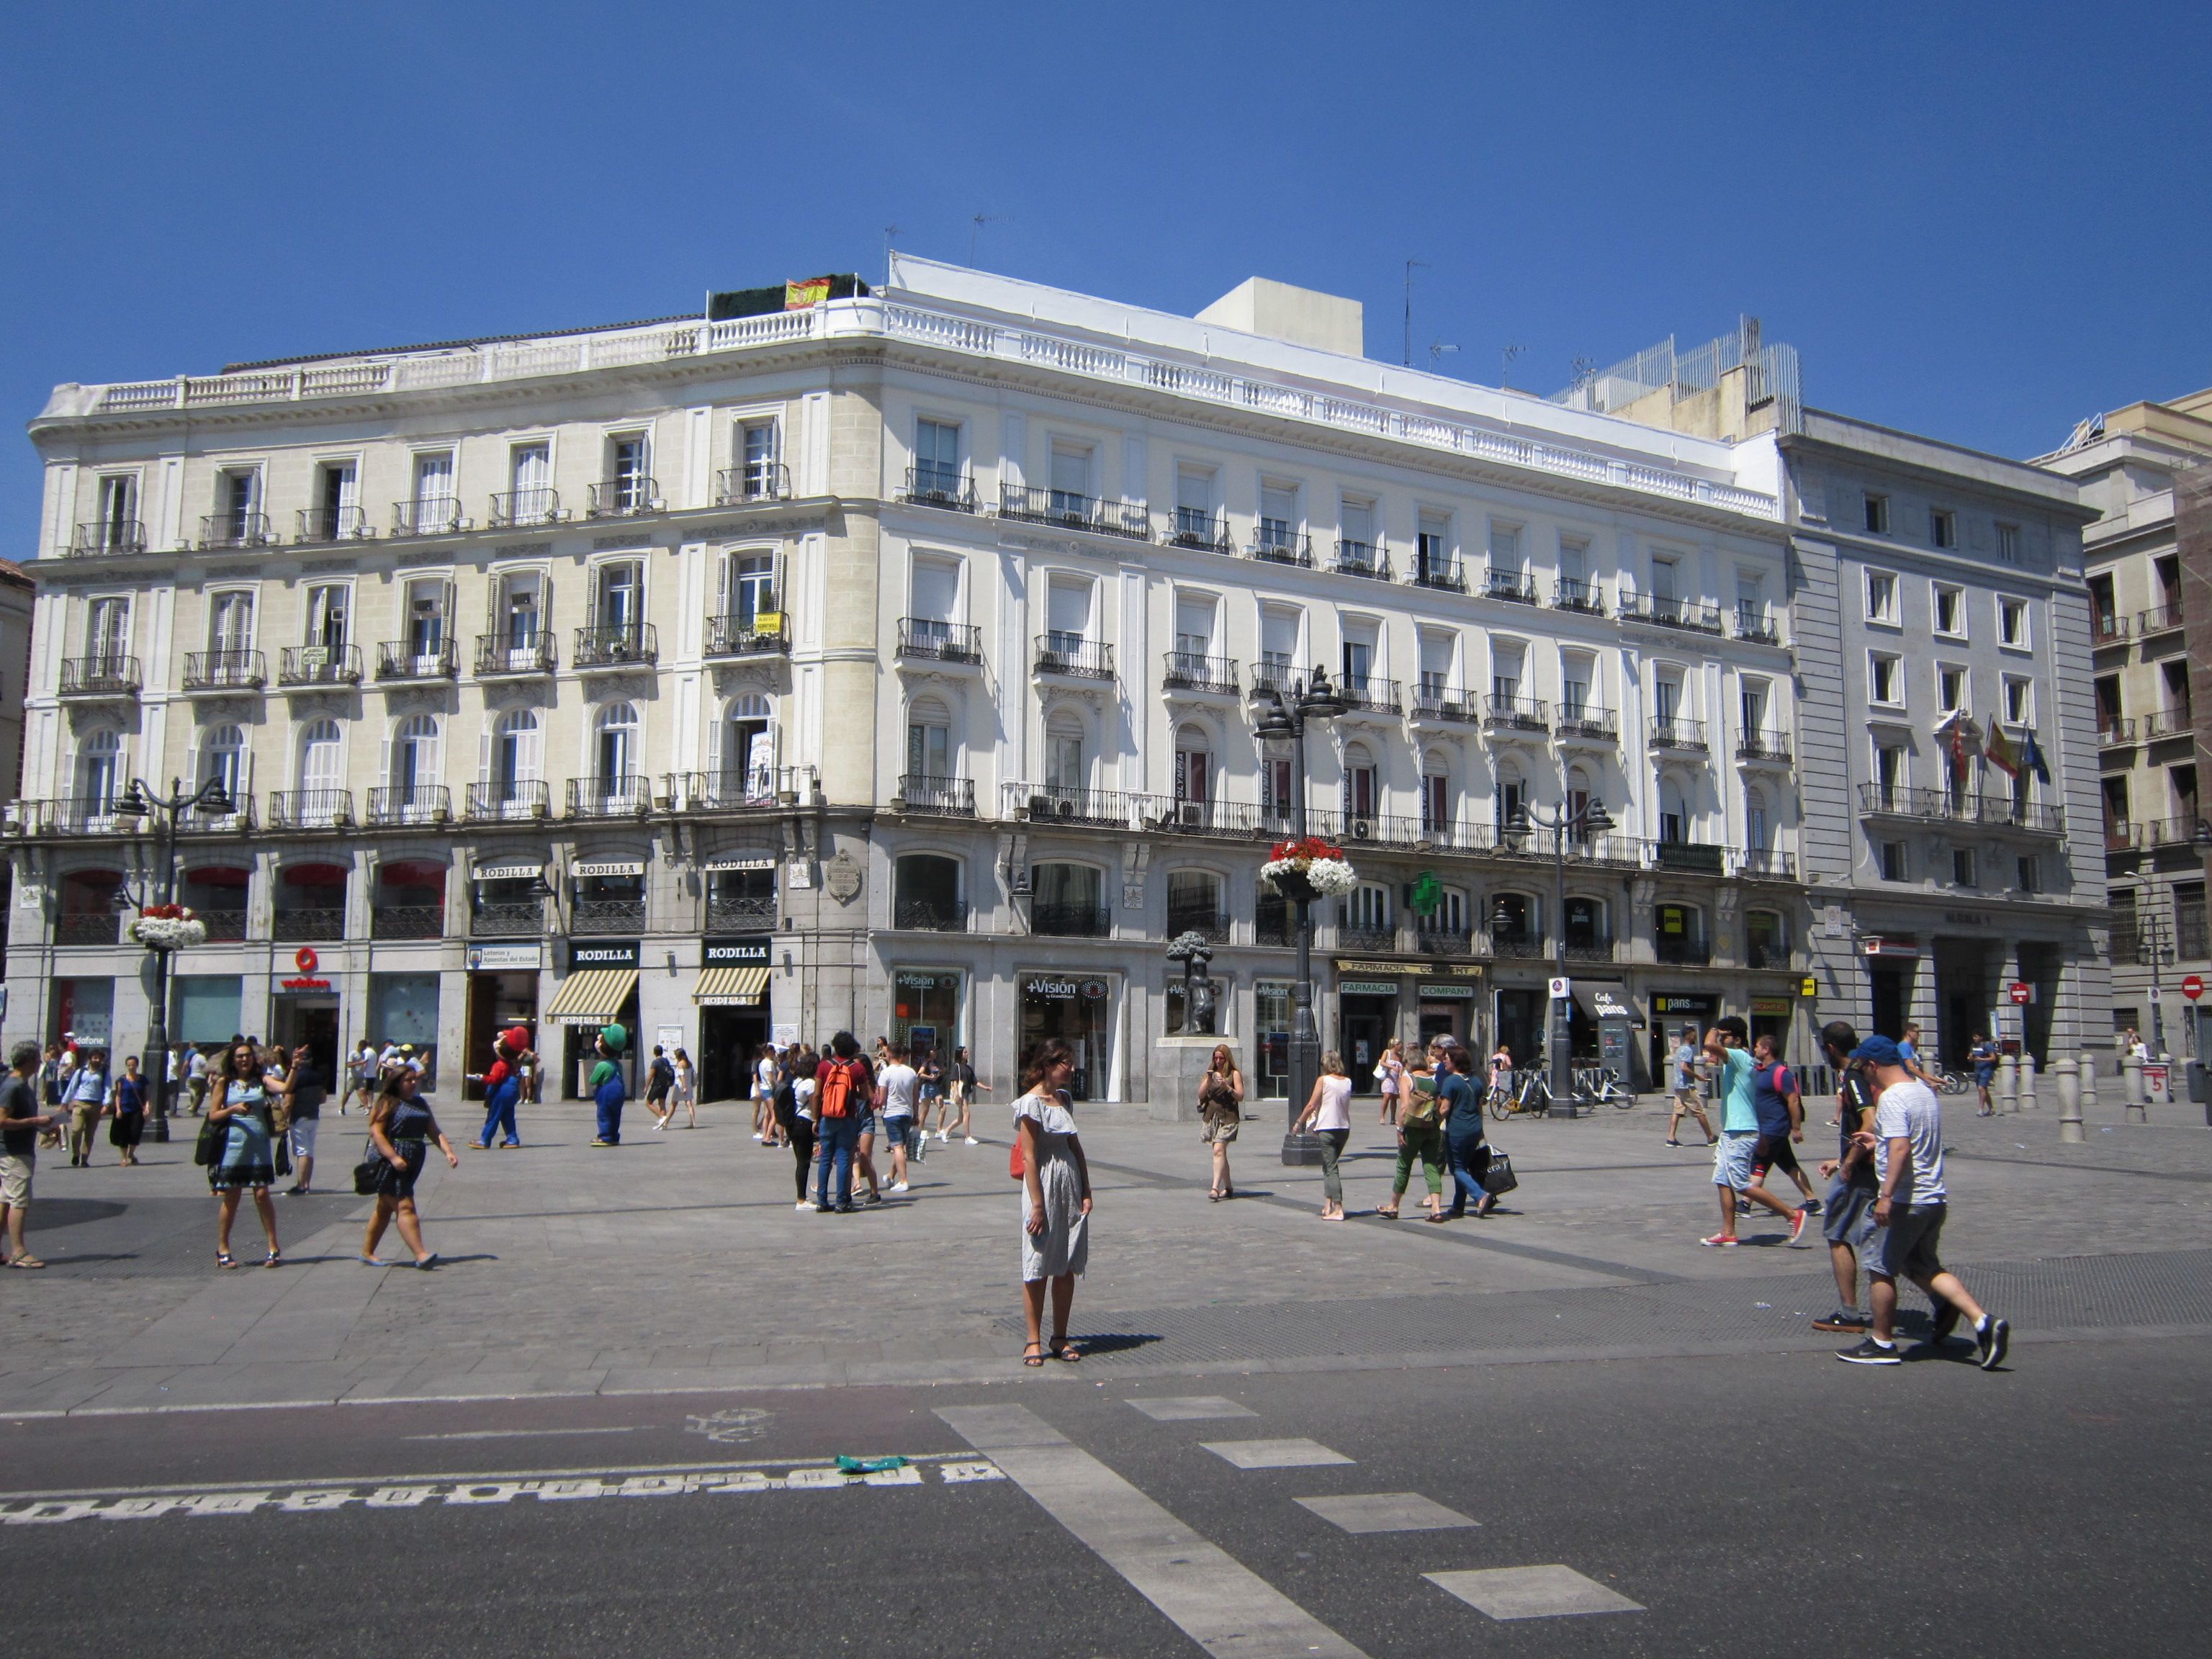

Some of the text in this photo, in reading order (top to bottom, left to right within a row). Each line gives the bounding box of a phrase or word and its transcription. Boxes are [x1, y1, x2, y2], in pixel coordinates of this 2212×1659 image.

[912, 728, 921, 776] OLYMPIA
[579, 864, 635, 874] RODILLA
[711, 858, 769, 869] RODILLA
[481, 867, 534, 878] RODILLA
[577, 949, 633, 961] RODILLA
[707, 947, 767, 959] RODILLA
[1352, 963, 1406, 972] FARMACIA
[281, 976, 331, 988] vodafone
[1342, 984, 1395, 993] FARMACIA
[1421, 986, 1470, 996] COMPANY
[1595, 992, 1613, 1004] Cafe
[1668, 998, 1691, 1011] pans
[1594, 1004, 1628, 1017] pans
[73, 1036, 104, 1045] odafone
